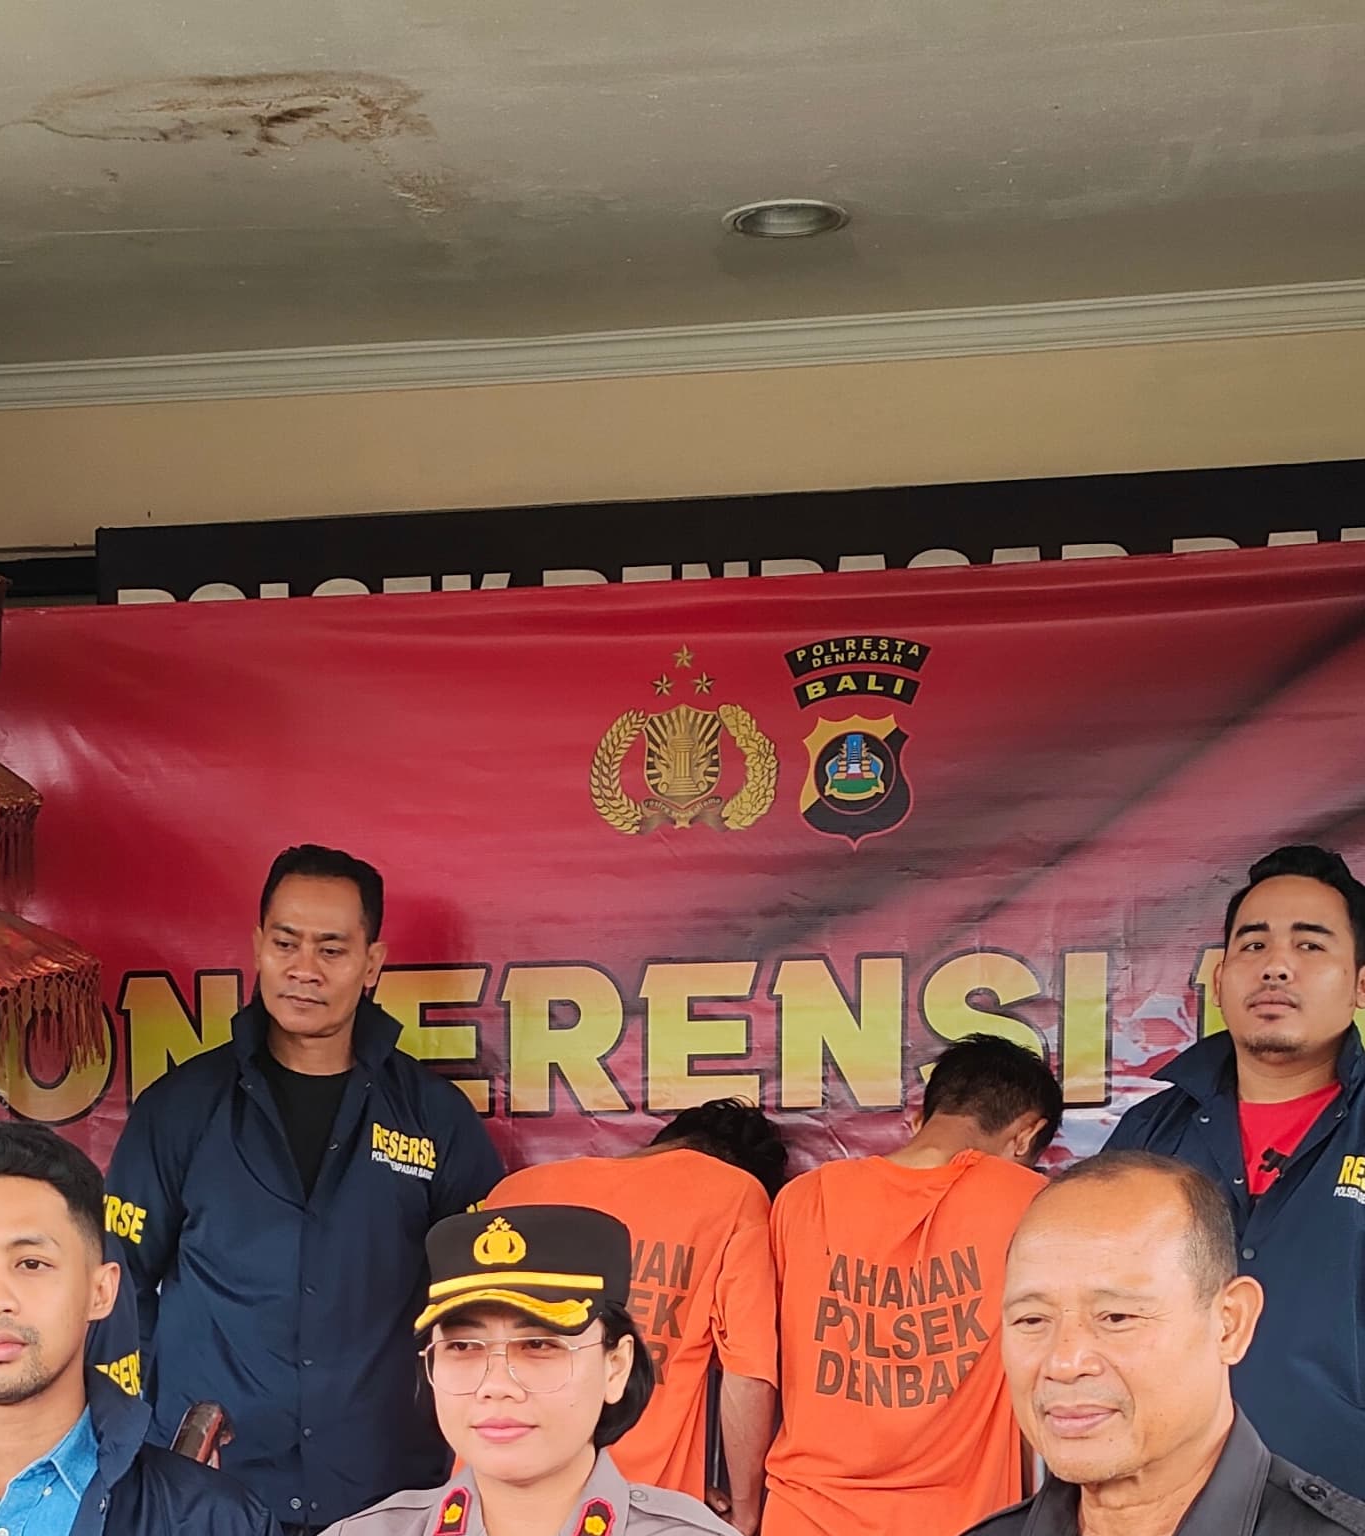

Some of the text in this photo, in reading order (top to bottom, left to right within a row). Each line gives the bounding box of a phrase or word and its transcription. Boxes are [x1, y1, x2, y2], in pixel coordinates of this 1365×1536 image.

[796, 637, 920, 662] POLRESTA
[811, 650, 903, 668] DENPASAR
[805, 673, 905, 700] BALI
[372, 1122, 437, 1170] RESERSE
[826, 1245, 982, 1311] AHANAN
[814, 1296, 990, 1360] POLSEK
